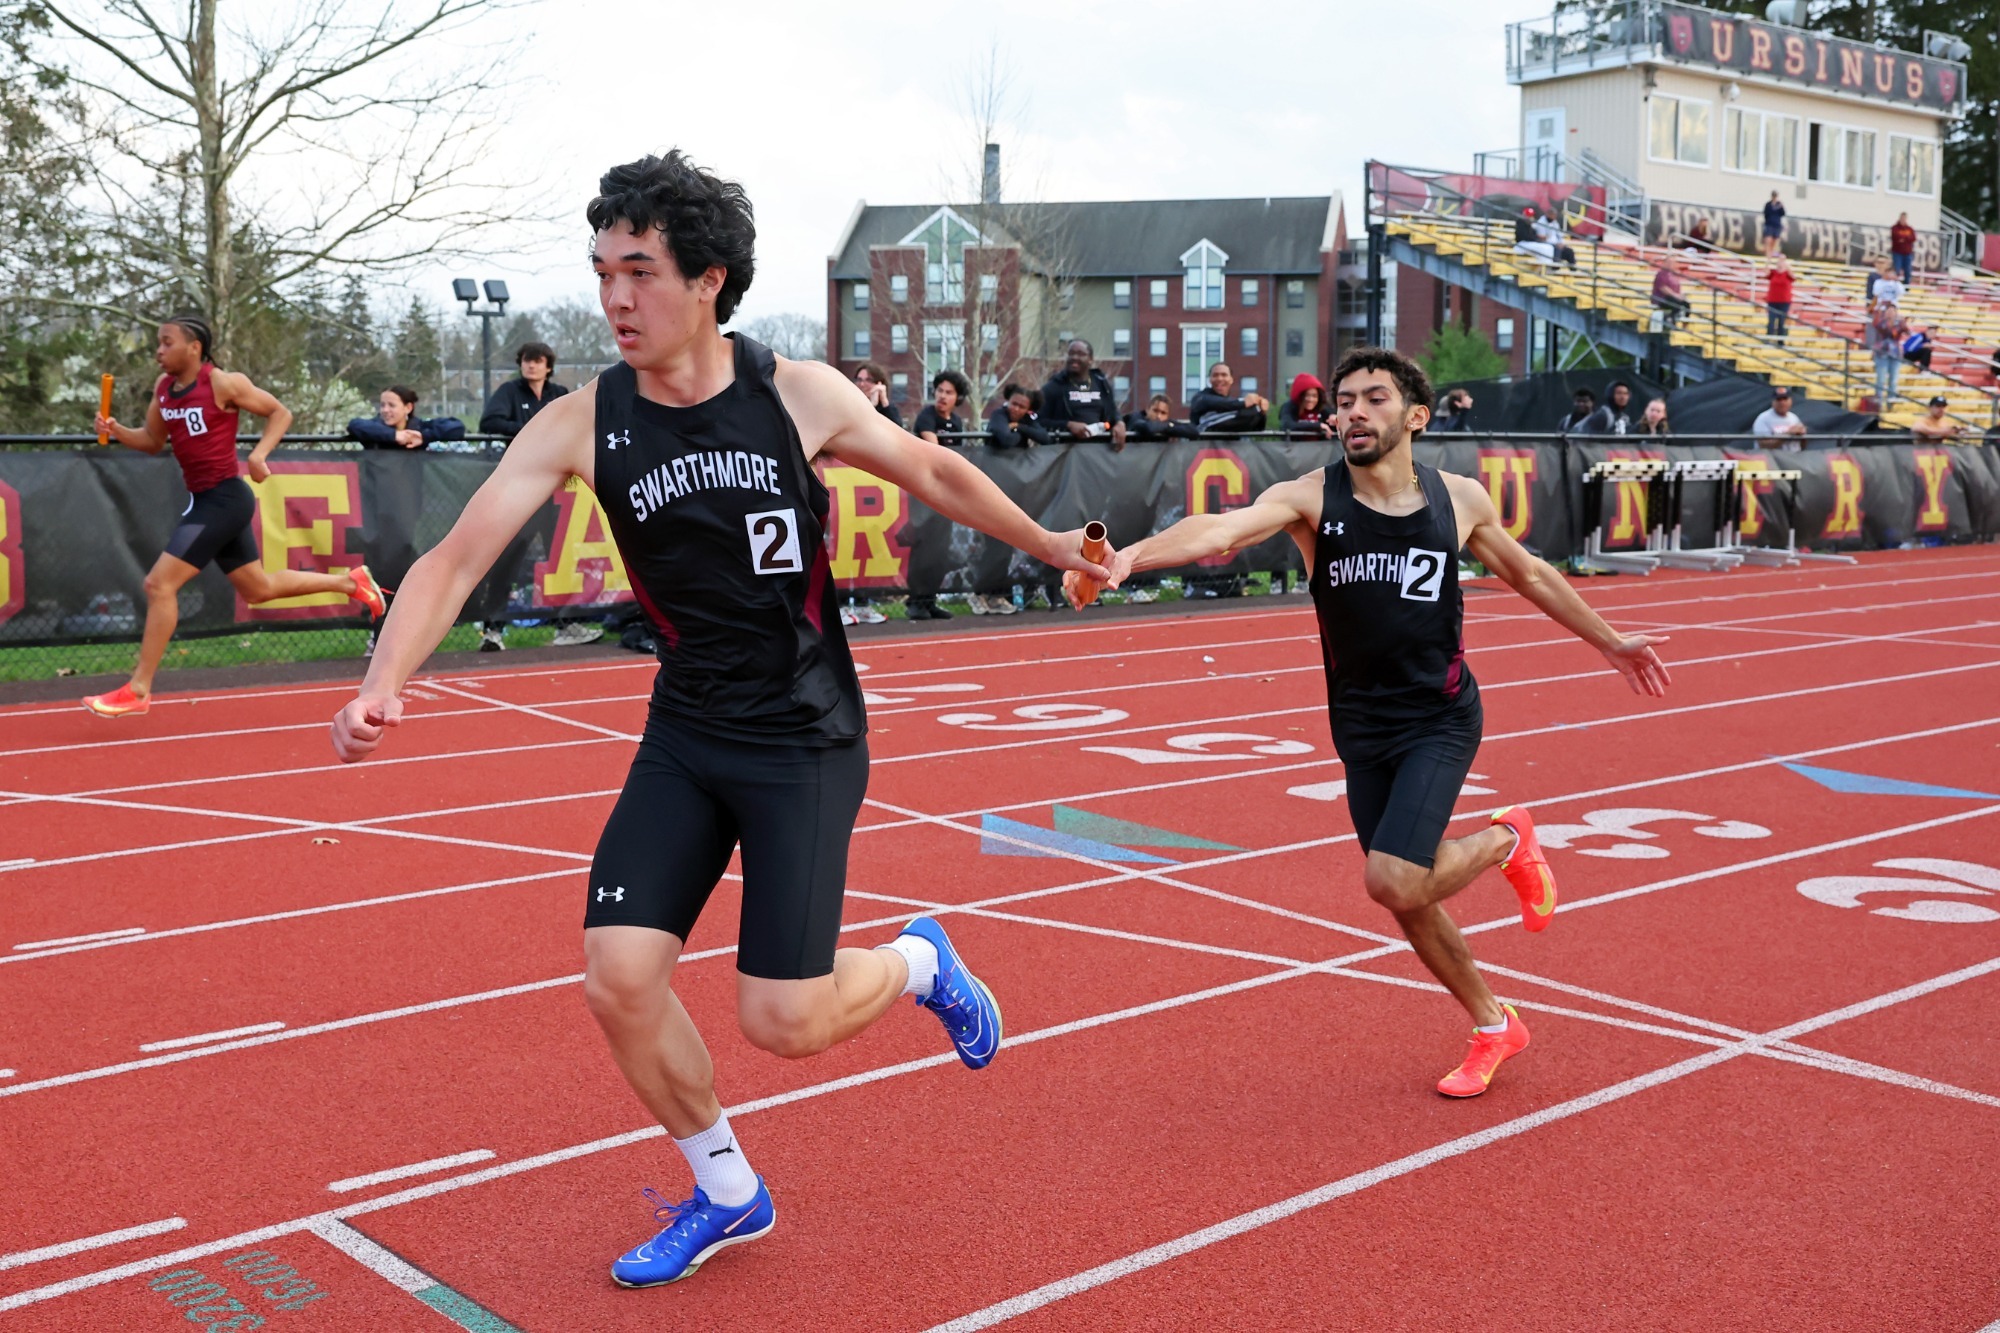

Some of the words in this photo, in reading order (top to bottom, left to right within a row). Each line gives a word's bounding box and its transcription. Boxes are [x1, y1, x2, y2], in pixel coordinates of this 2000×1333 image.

[1710, 20, 1924, 99] URSINUS
[1799, 220, 1851, 262] THE
[188, 411, 202, 432] 8
[628, 451, 782, 522] SWARTHMORE
[753, 516, 794, 570] 2
[1406, 554, 1439, 597] 2
